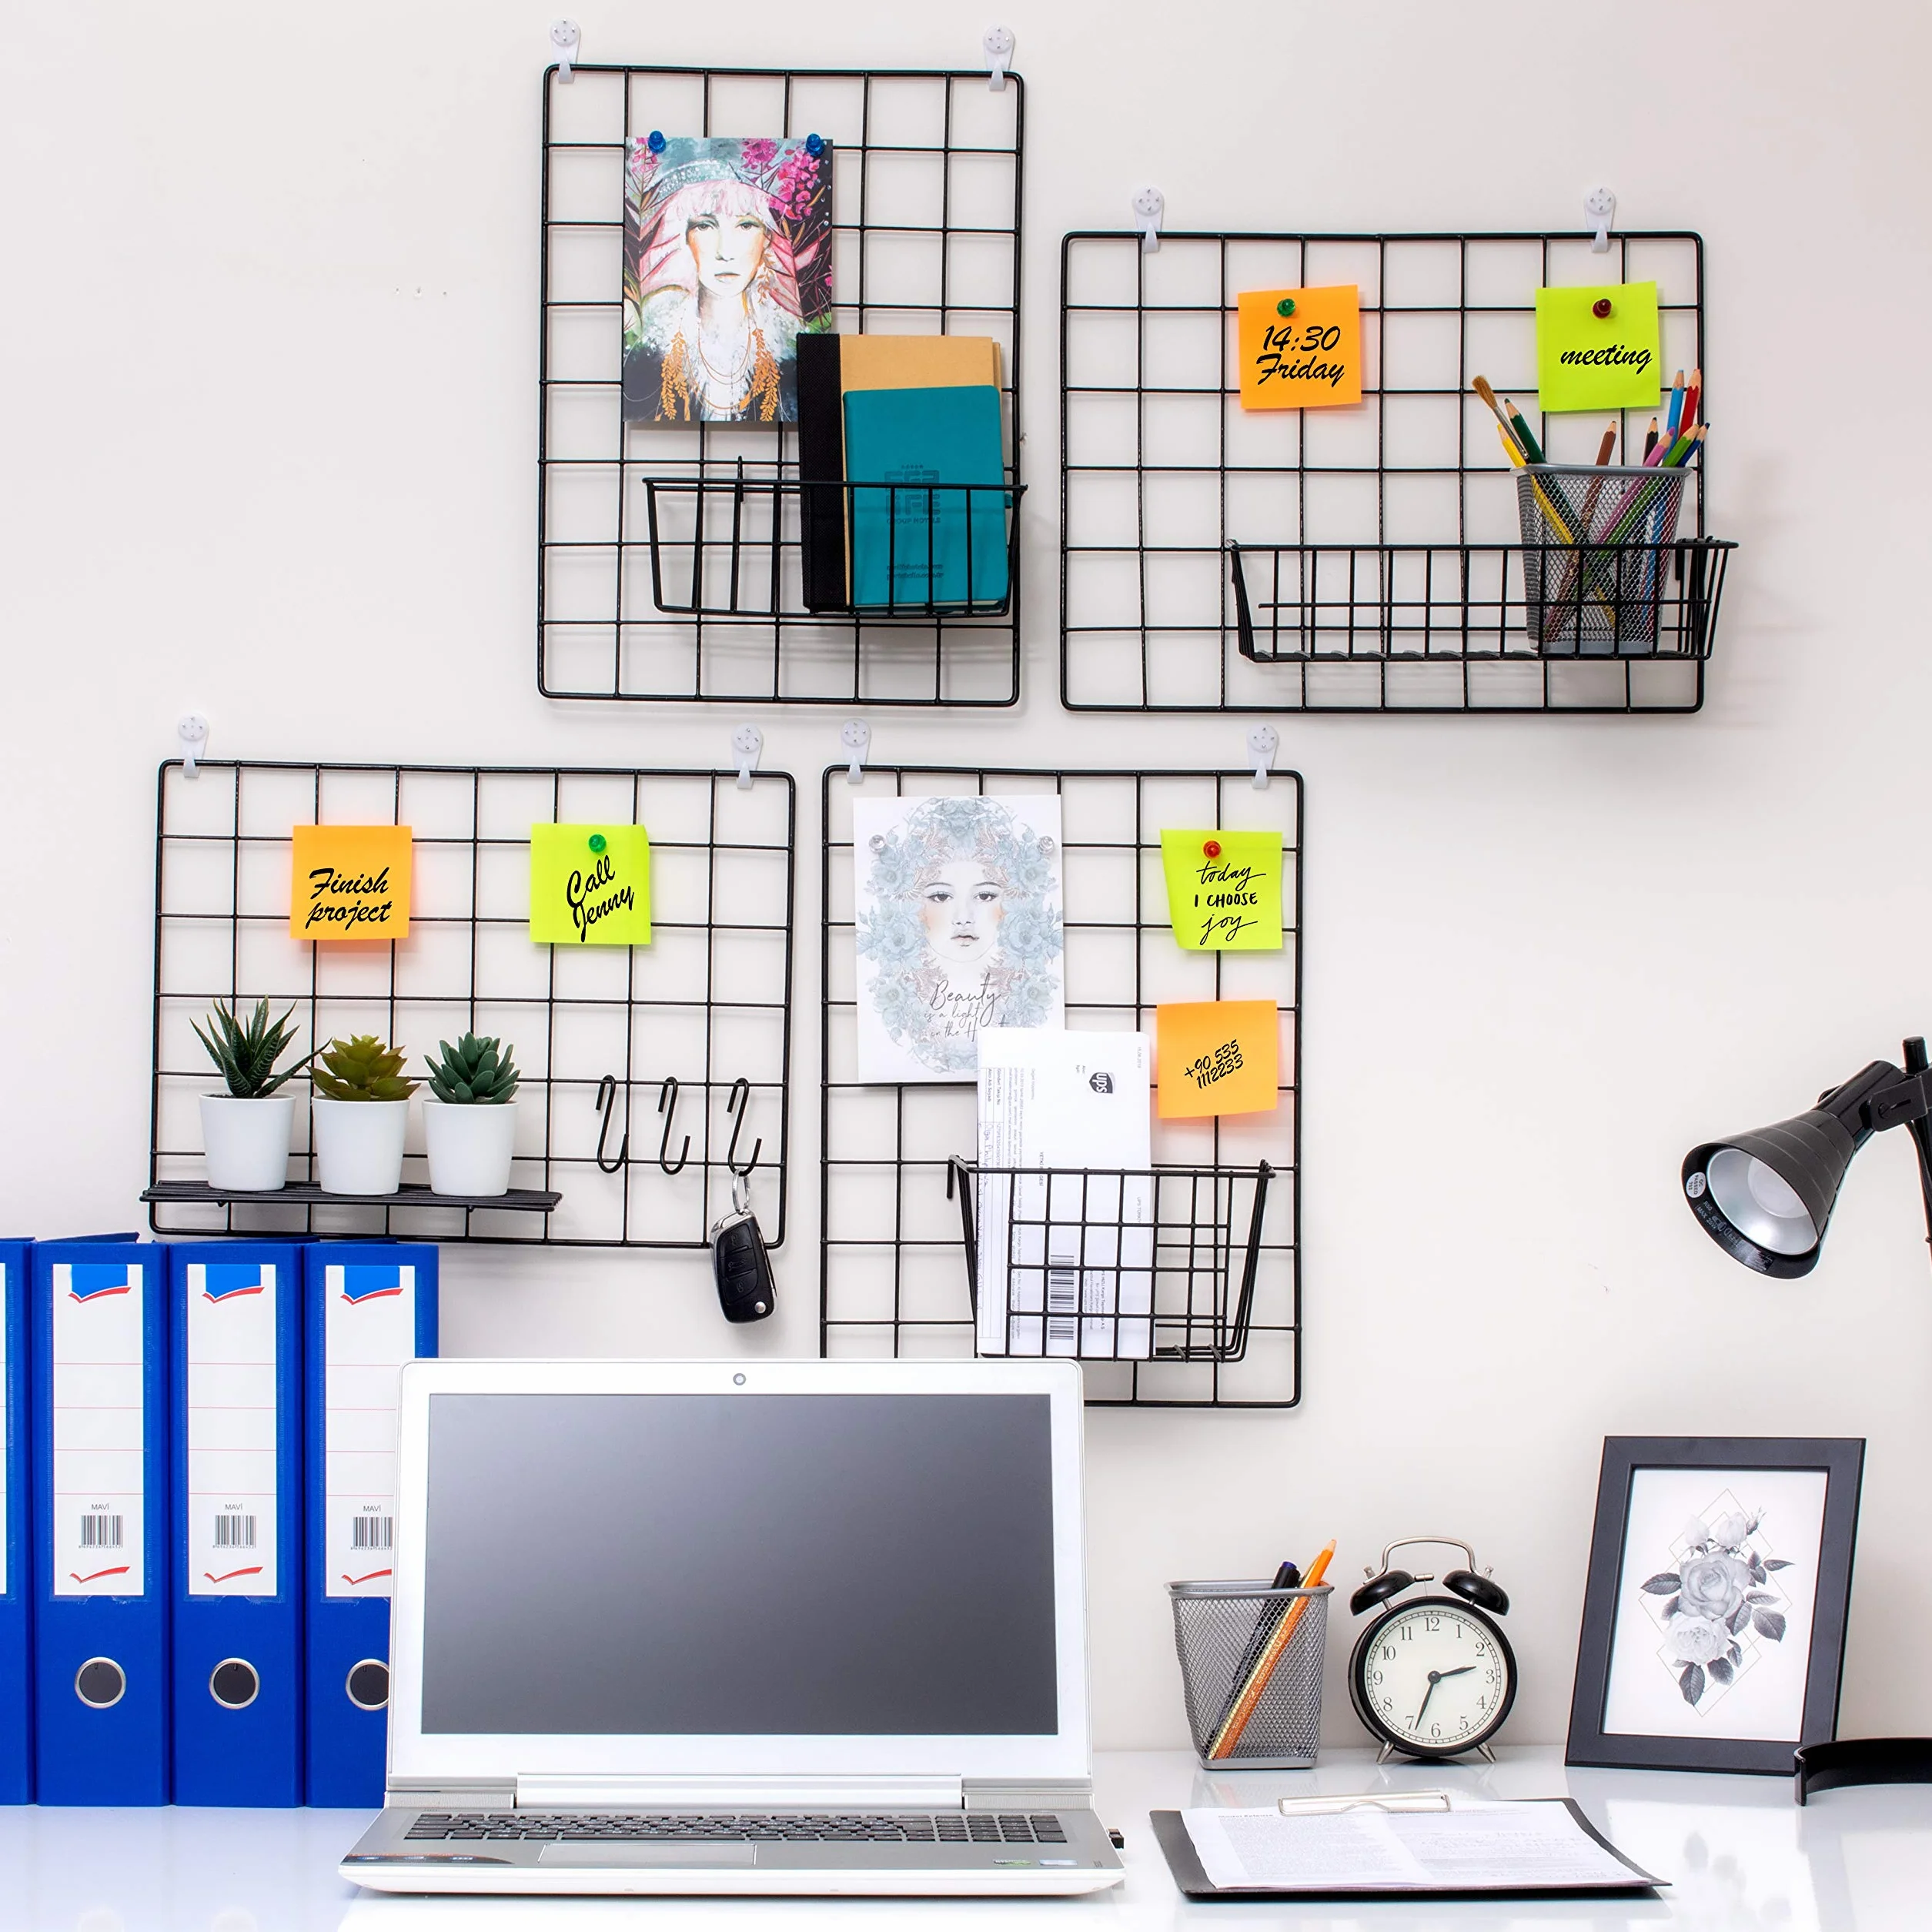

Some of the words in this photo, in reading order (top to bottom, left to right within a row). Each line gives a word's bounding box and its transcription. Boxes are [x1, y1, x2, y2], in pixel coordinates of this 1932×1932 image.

[1262, 325, 1341, 353] 14:30
[1560, 344, 1653, 375] meeting
[1255, 353, 1345, 388] Friday
[309, 867, 390, 900] Finish
[567, 854, 616, 909] Call
[1195, 860, 1267, 892] today
[1194, 894, 1198, 908] I
[1206, 892, 1258, 908] CHOOSE
[305, 900, 393, 931] project
[572, 885, 635, 943] Jenny
[1199, 913, 1258, 946] joy
[929, 972, 1002, 1028] Beauty
[1184, 1055, 1212, 1078] +90
[1215, 1038, 1239, 1065] 535
[1196, 1053, 1244, 1089] 1112233
[1091, 1072, 1108, 1093] ups
[91, 1502, 109, 1511] MAVİ
[225, 1502, 243, 1511] MAVİ
[363, 1504, 382, 1513] MAVİ
[1425, 1616, 1440, 1632] 12
[1456, 1624, 1462, 1639] 1
[1401, 1626, 1413, 1641] 11
[1382, 1646, 1396, 1660] 10
[1475, 1642, 1485, 1656] 2
[1373, 1670, 1383, 1685] 9
[1486, 1669, 1495, 1684] 3
[1383, 1696, 1392, 1711] 8
[1476, 1695, 1486, 1710] 4
[1405, 1715, 1414, 1730] 7
[1431, 1723, 1441, 1737] 6
[1459, 1716, 1469, 1730] 5
